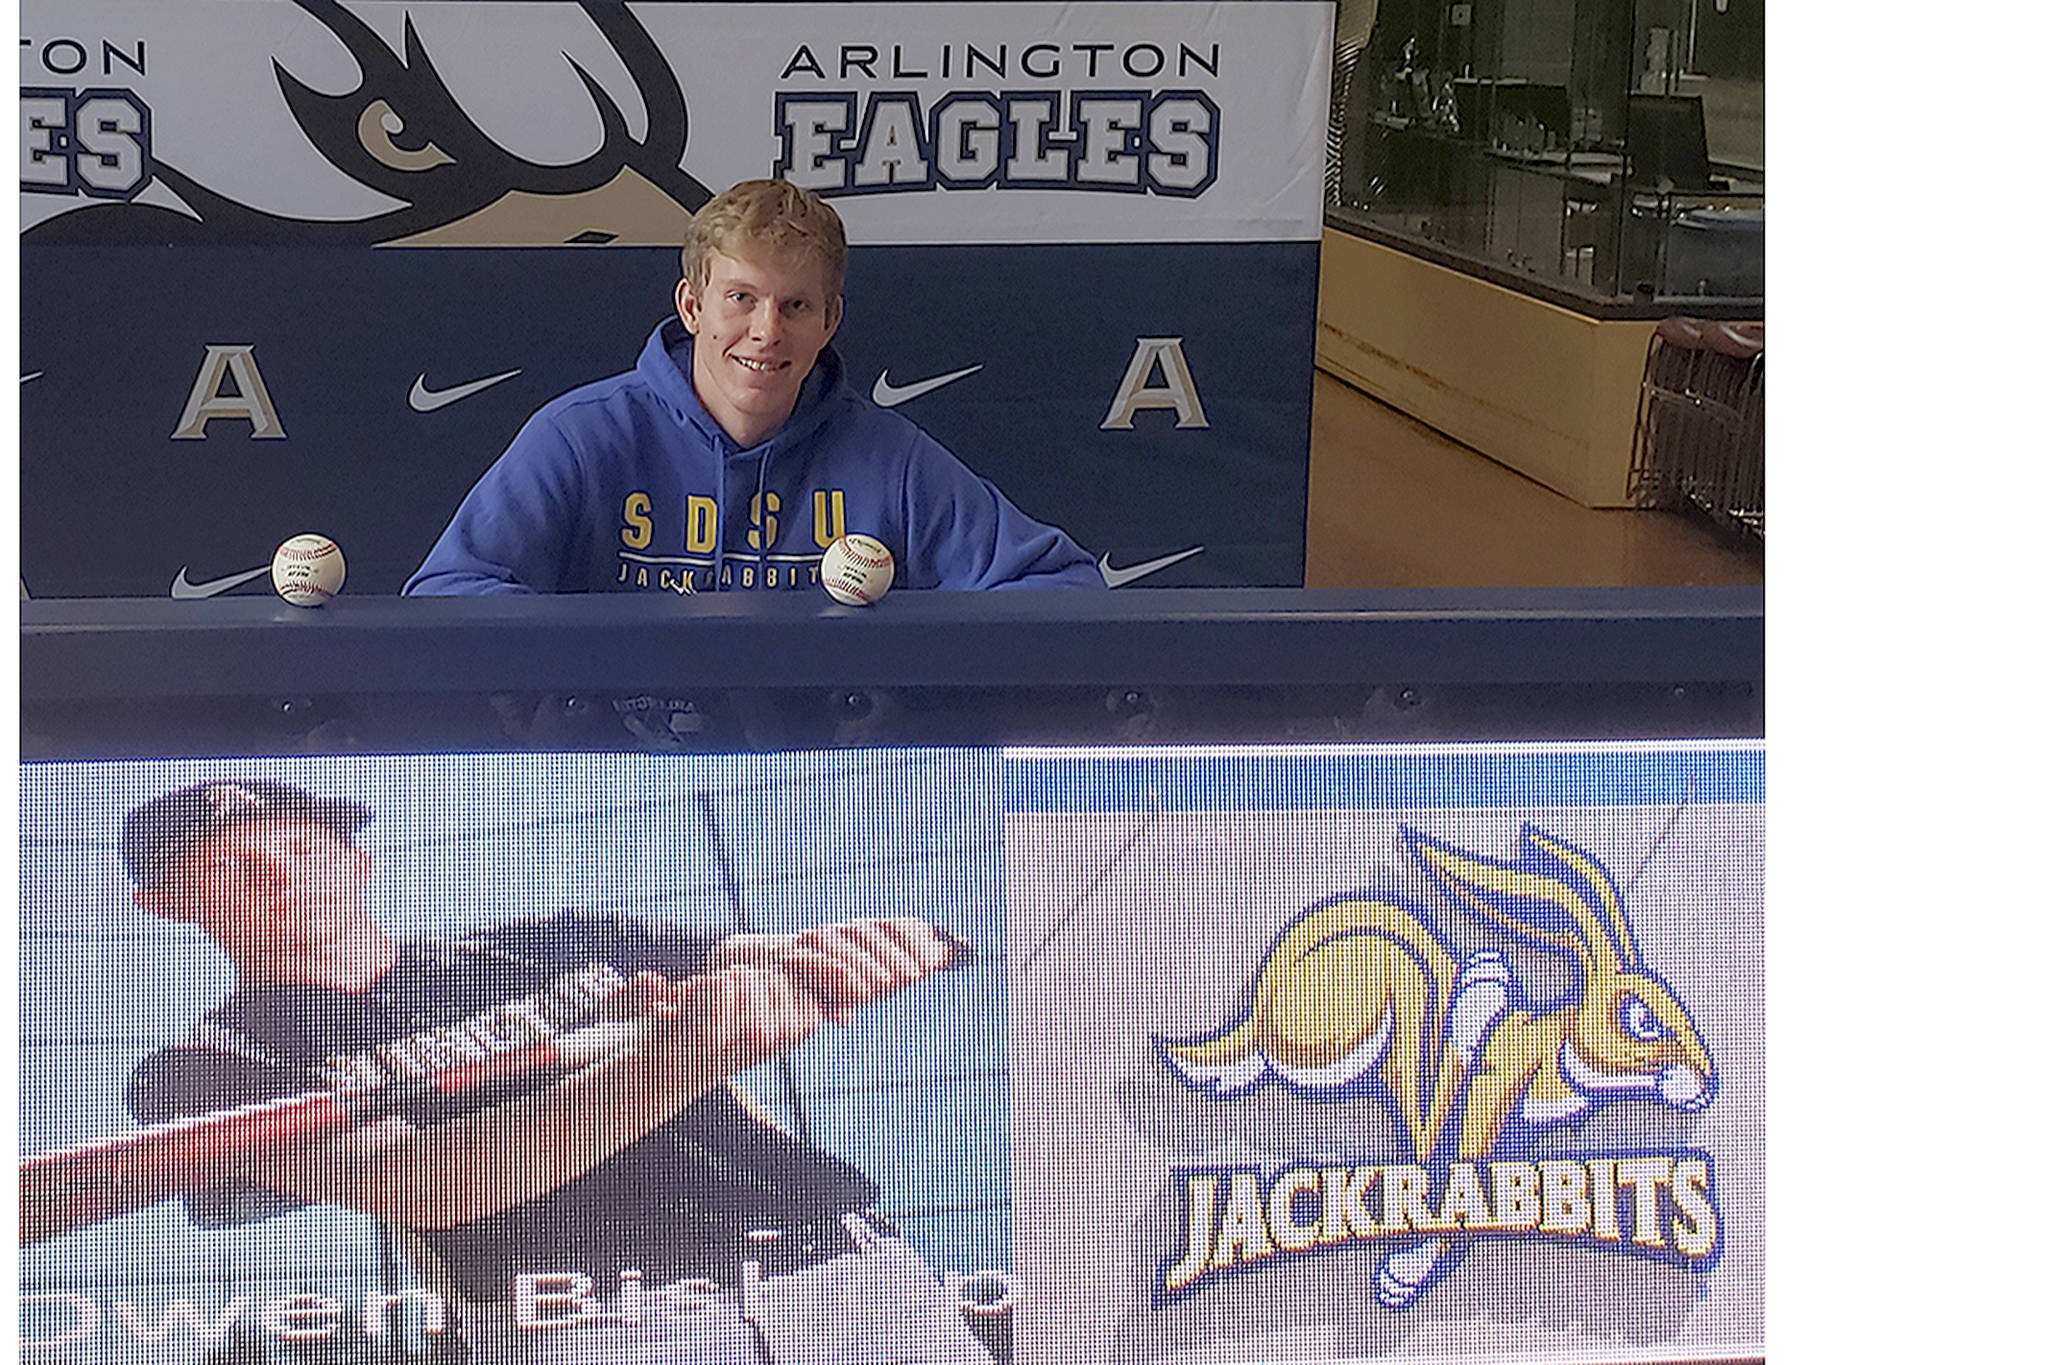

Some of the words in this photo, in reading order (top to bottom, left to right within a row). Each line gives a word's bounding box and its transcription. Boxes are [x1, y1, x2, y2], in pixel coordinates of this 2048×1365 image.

[20, 40, 146, 76] ON
[780, 44, 1220, 80] ARLINGTON
[774, 90, 1221, 198] EAGLES
[171, 344, 287, 440] A
[1101, 337, 1209, 429] A
[1162, 1155, 1719, 1298] JACKRABBITS
[514, 1260, 1022, 1328] Bisp
